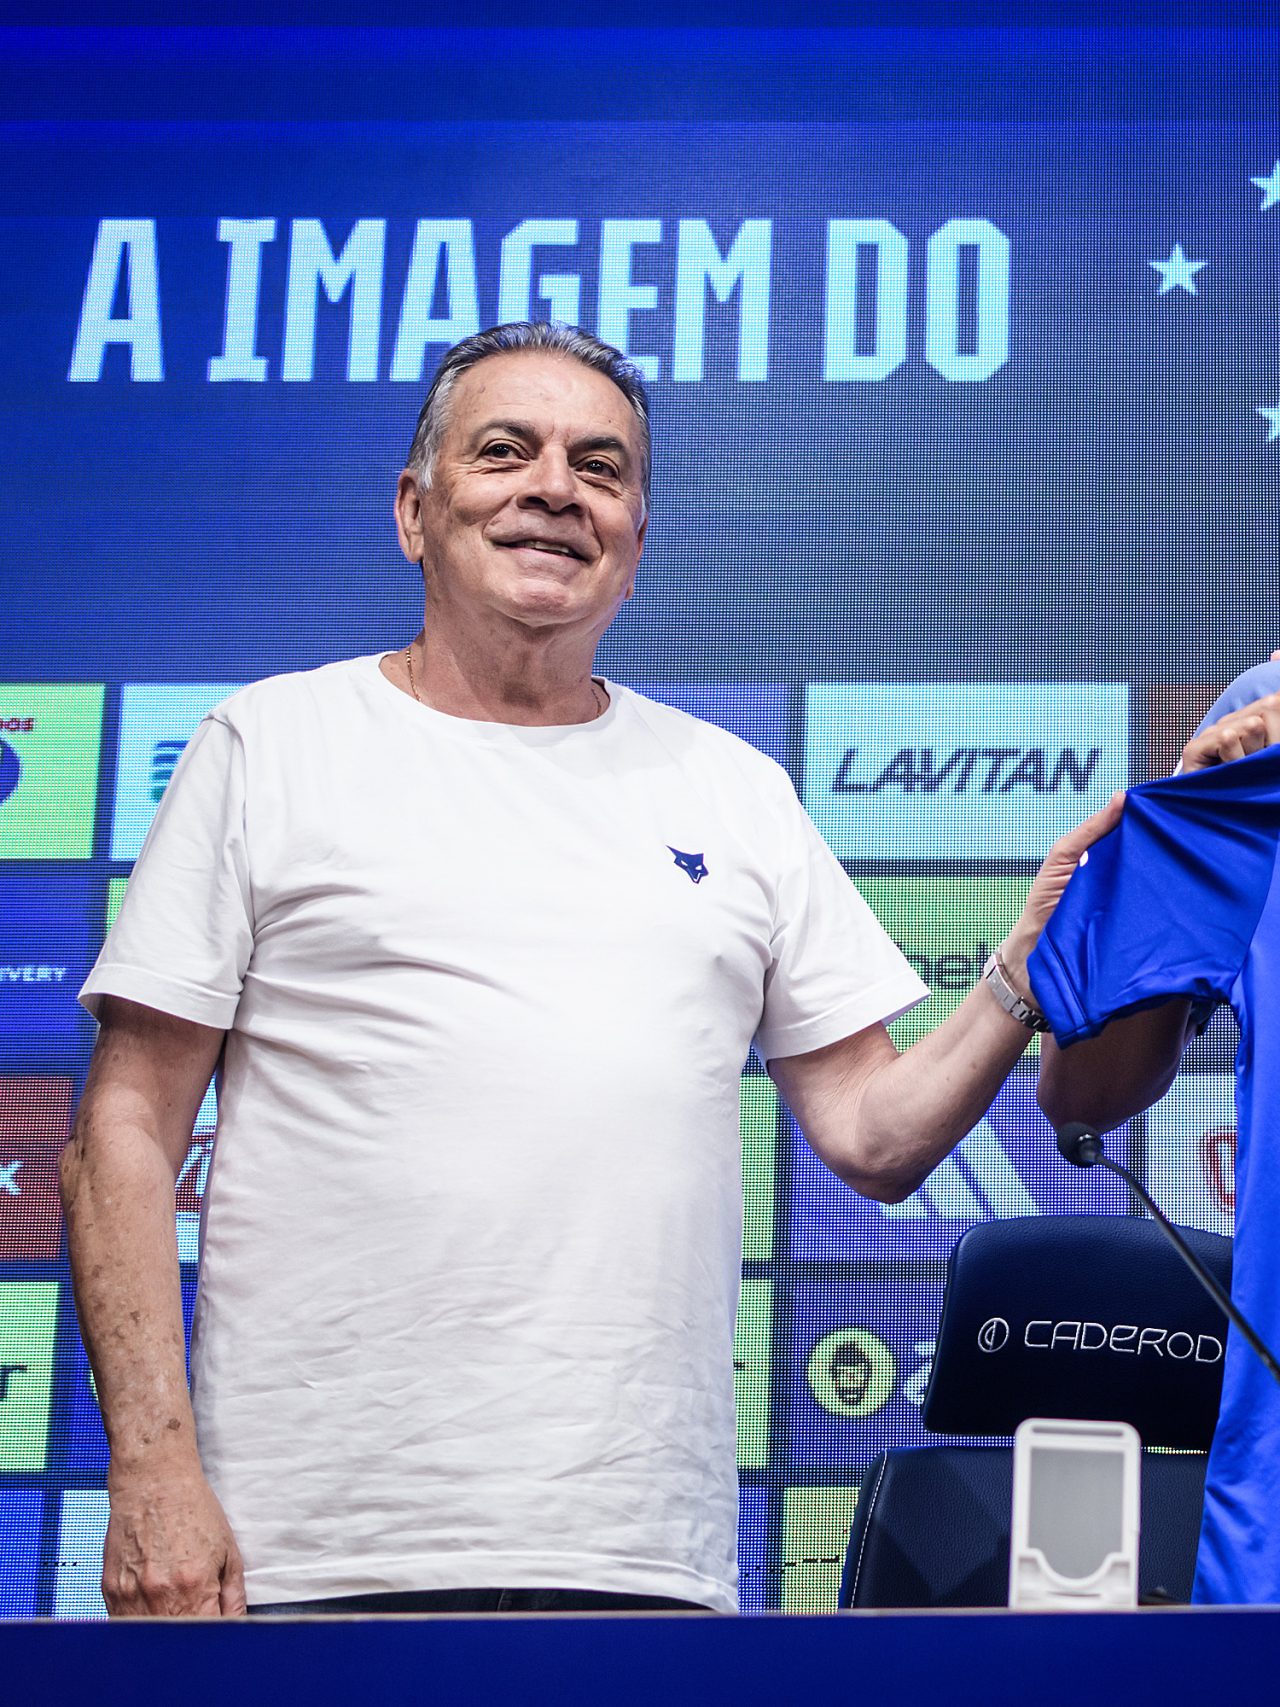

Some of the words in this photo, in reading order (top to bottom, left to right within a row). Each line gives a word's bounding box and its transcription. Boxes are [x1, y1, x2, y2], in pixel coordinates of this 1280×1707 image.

[67, 218, 164, 382] A
[206, 218, 773, 382] IMAGEM
[823, 218, 1010, 382] DO
[831, 748, 1100, 795] LAVITAN
